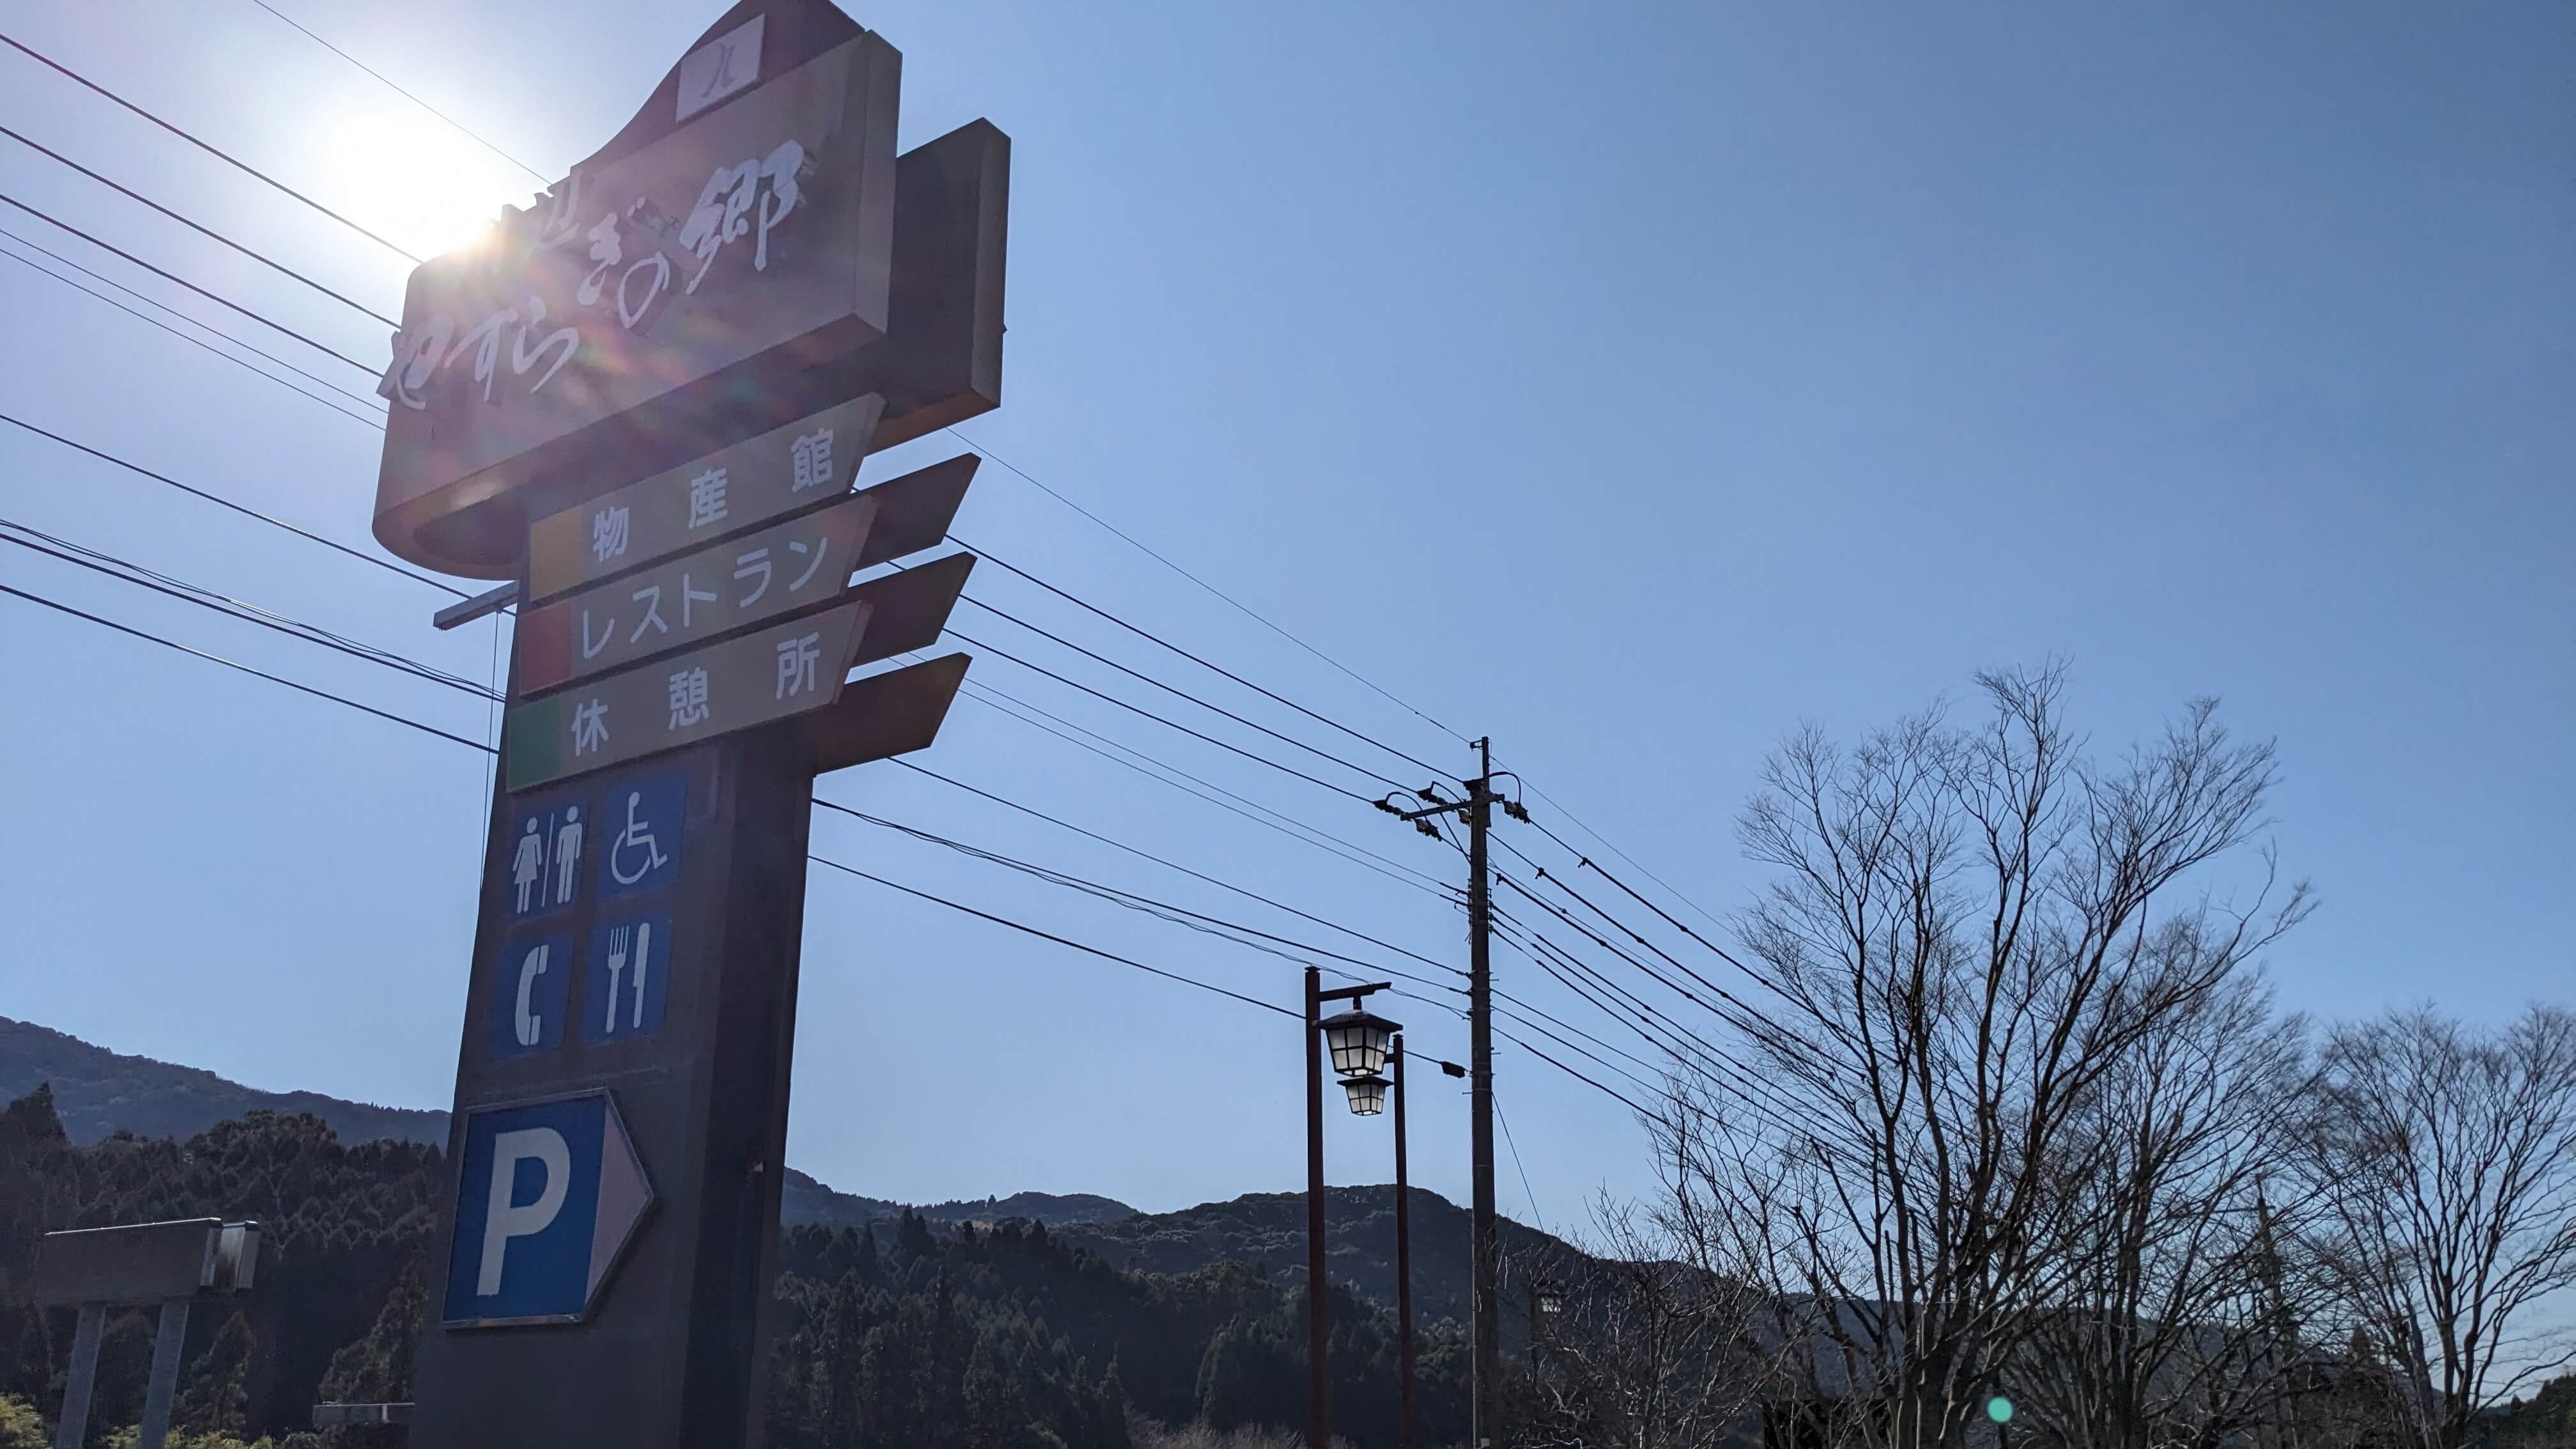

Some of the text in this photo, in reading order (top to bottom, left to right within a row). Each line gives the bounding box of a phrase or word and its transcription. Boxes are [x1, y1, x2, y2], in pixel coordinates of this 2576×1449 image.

[593, 428, 834, 562] 物産館
[582, 537, 829, 659] レストラン
[571, 631, 820, 756] 休憩所
[477, 1127, 571, 1296] P
